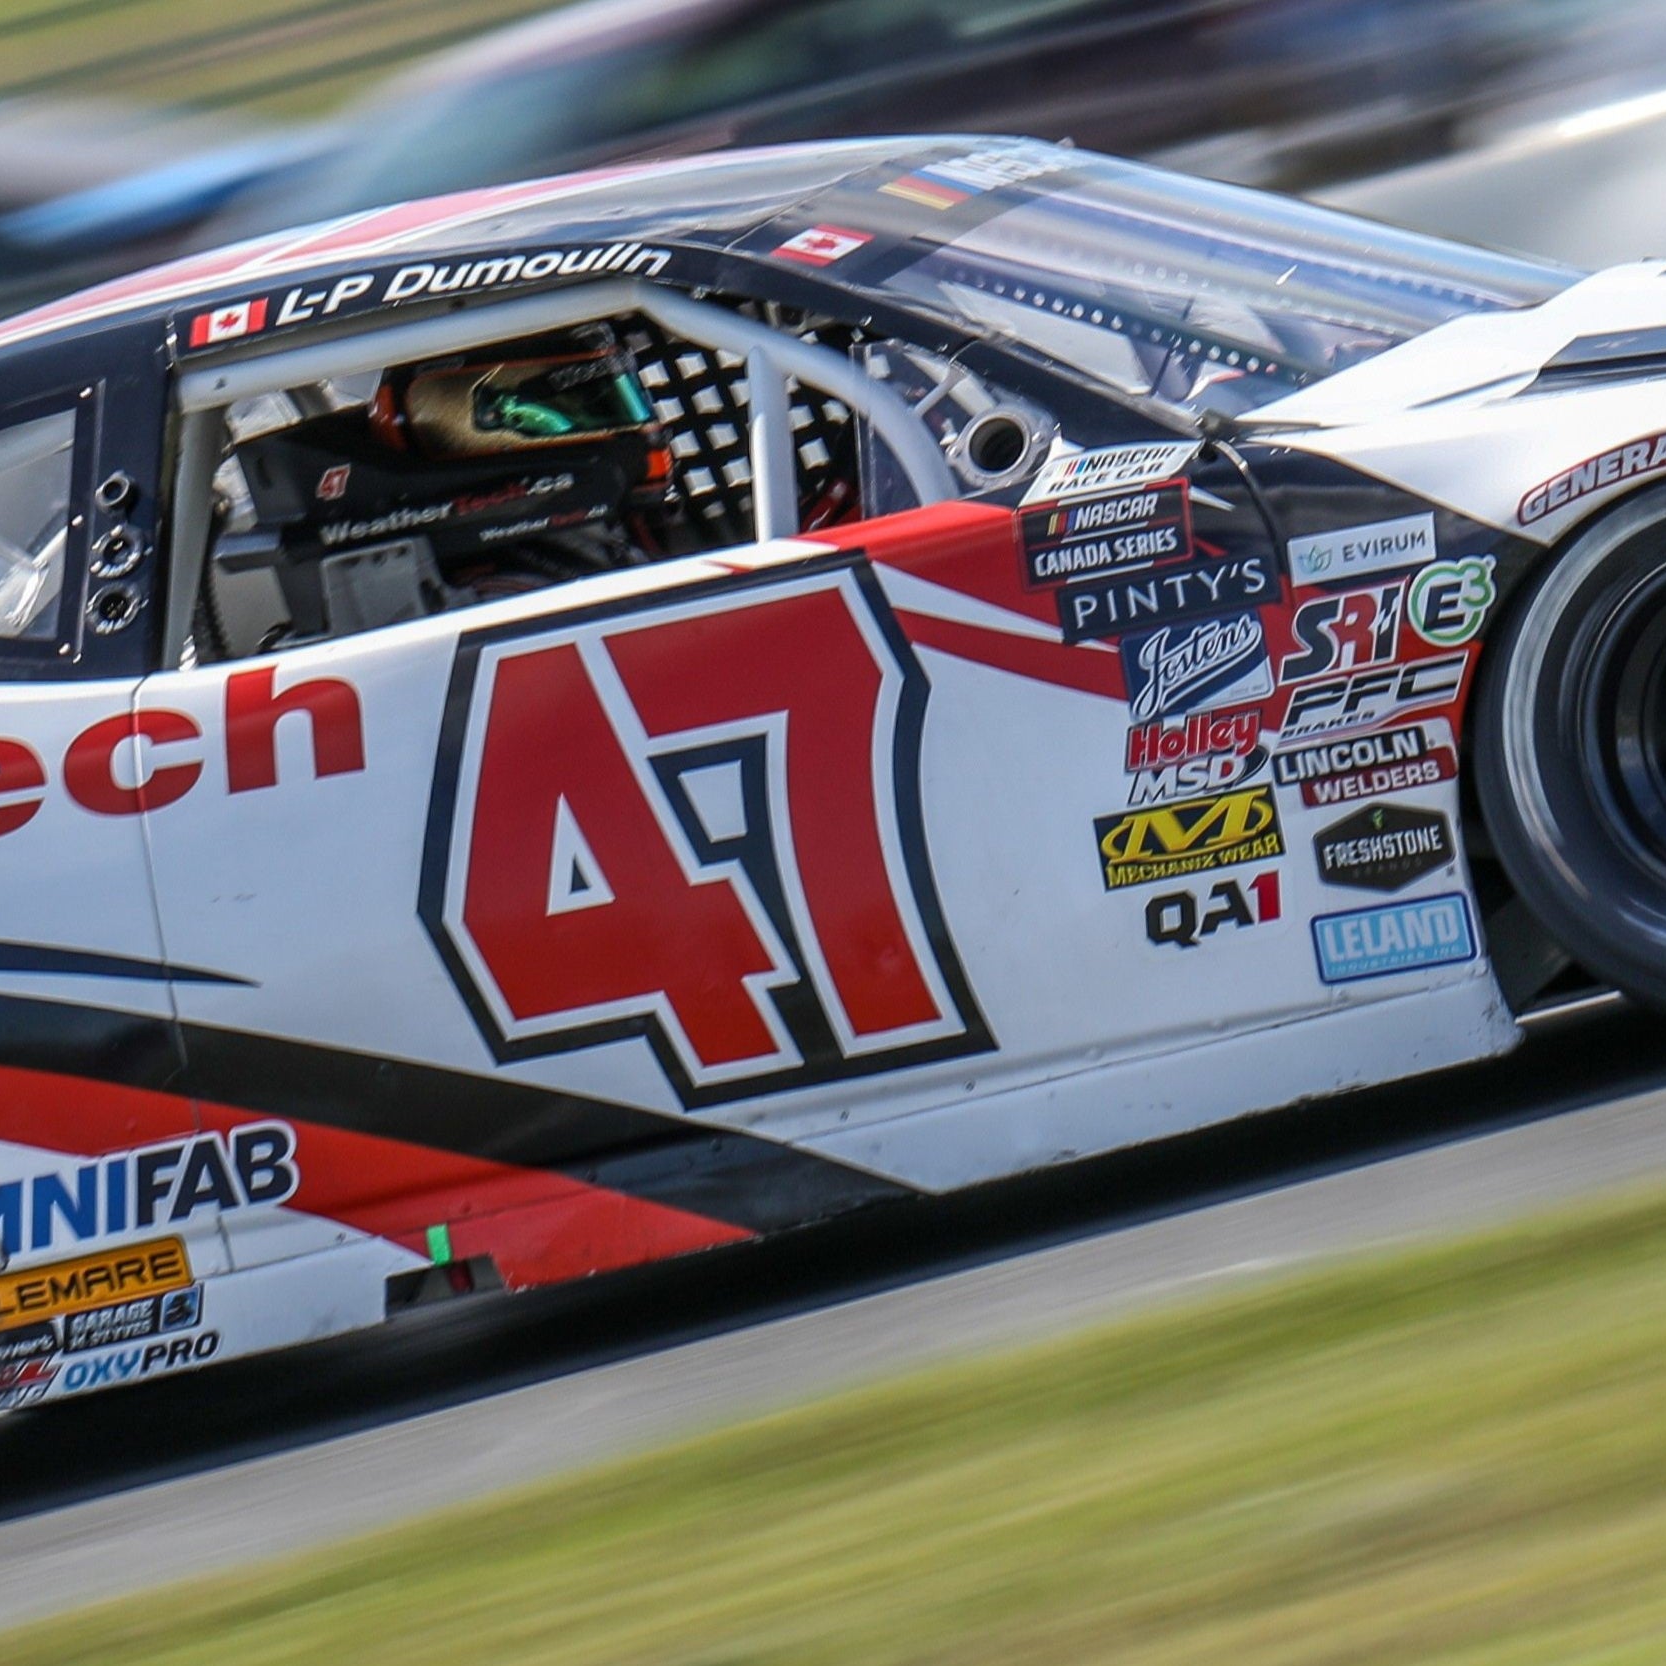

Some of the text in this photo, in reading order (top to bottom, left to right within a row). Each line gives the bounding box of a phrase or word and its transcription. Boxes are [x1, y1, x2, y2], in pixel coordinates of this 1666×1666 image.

[274, 242, 673, 327] L-P Dumoulin
[1085, 446, 1177, 472] NASCAR
[1115, 461, 1165, 480] CAR
[1074, 493, 1159, 531] NASCAR
[1034, 527, 1178, 577] CANADA SERIES
[1342, 529, 1428, 563] EVIRUM
[1073, 557, 1267, 629] PINTY'S
[1133, 613, 1262, 720] Jostens
[1283, 652, 1468, 728] PFC
[1126, 709, 1261, 773] Holley
[1278, 730, 1420, 783] LINCOLN
[1128, 755, 1246, 806] MSD
[1312, 759, 1441, 804] WELDERS
[441, 566, 967, 1088] 47
[1323, 824, 1444, 871] FRESHSTONE
[1106, 833, 1280, 888] MECHANIX WEAR
[1144, 869, 1282, 950] QA1
[1323, 905, 1460, 962] LELAND
[70, 1298, 155, 1335] GARAGE
[63, 1330, 221, 1390] OXYPRO
